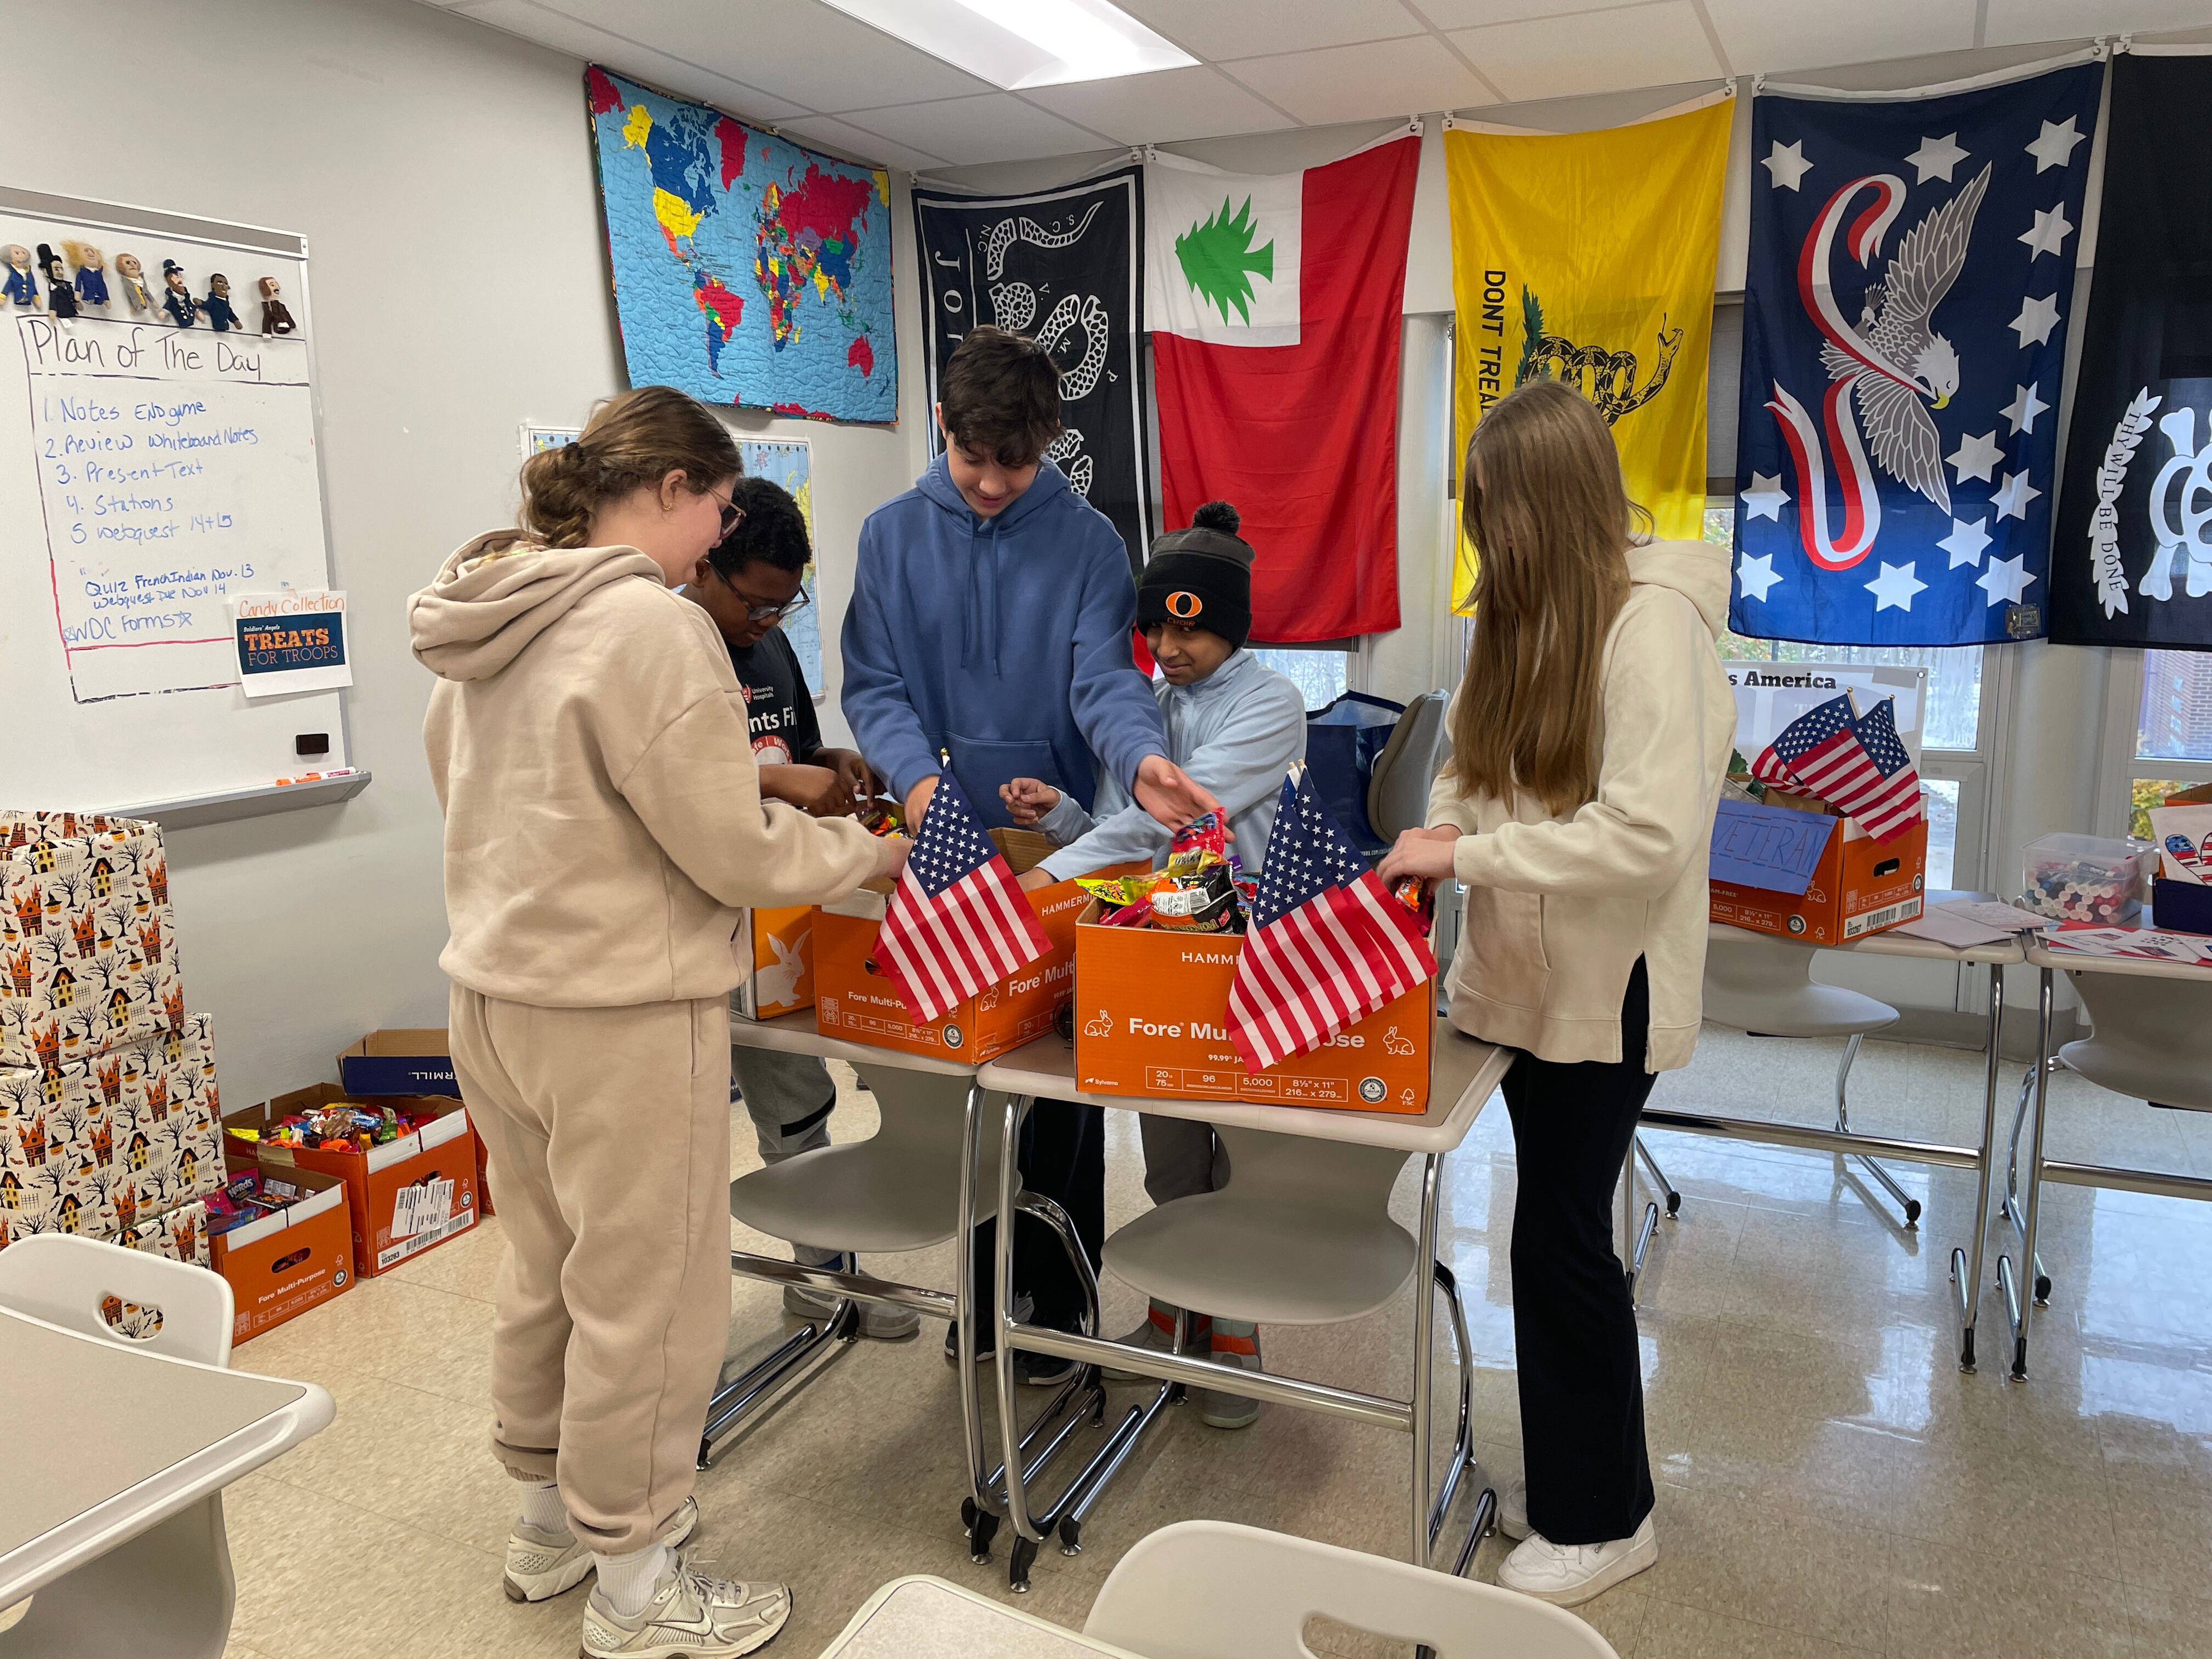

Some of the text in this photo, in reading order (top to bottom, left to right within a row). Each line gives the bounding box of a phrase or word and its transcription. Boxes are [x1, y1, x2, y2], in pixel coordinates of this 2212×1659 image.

[978, 224, 992, 254] N.C.
[935, 250, 964, 343] JOI
[1482, 270, 1506, 337] DONT
[27, 320, 105, 368] Plan
[156, 331, 204, 371] The
[217, 341, 261, 380] Day
[1057, 336, 1072, 354] M.
[61, 397, 120, 423] Notes
[56, 458, 203, 484] 3. Present Text
[66, 493, 174, 515] 4. Stations
[2099, 412, 2141, 591] THY WILL BE DONE
[242, 563, 254, 578] 13
[182, 586, 208, 599] Nov
[215, 582, 226, 595] 14
[239, 592, 345, 618] Candy Collection
[244, 628, 330, 652] TREATS
[248, 645, 339, 666] FOR TROOPS
[751, 686, 774, 694] University
[1744, 671, 1837, 689] America
[753, 692, 774, 701] Hospitals
[749, 706, 797, 733] nts Fi
[1710, 888, 1738, 898] AM-FREE
[1009, 976, 1040, 997] Fore
[1045, 961, 1075, 984] Mult
[849, 991, 907, 1010] Fore Multi-Pu
[1129, 1017, 1182, 1038] Fore
[411, 1072, 456, 1080] RMILL
[1202, 1074, 1216, 1083] 96
[1242, 1077, 1273, 1087] 5,000
[258, 1292, 275, 1304] Fore
[277, 1269, 326, 1296] Multi-Purpose
